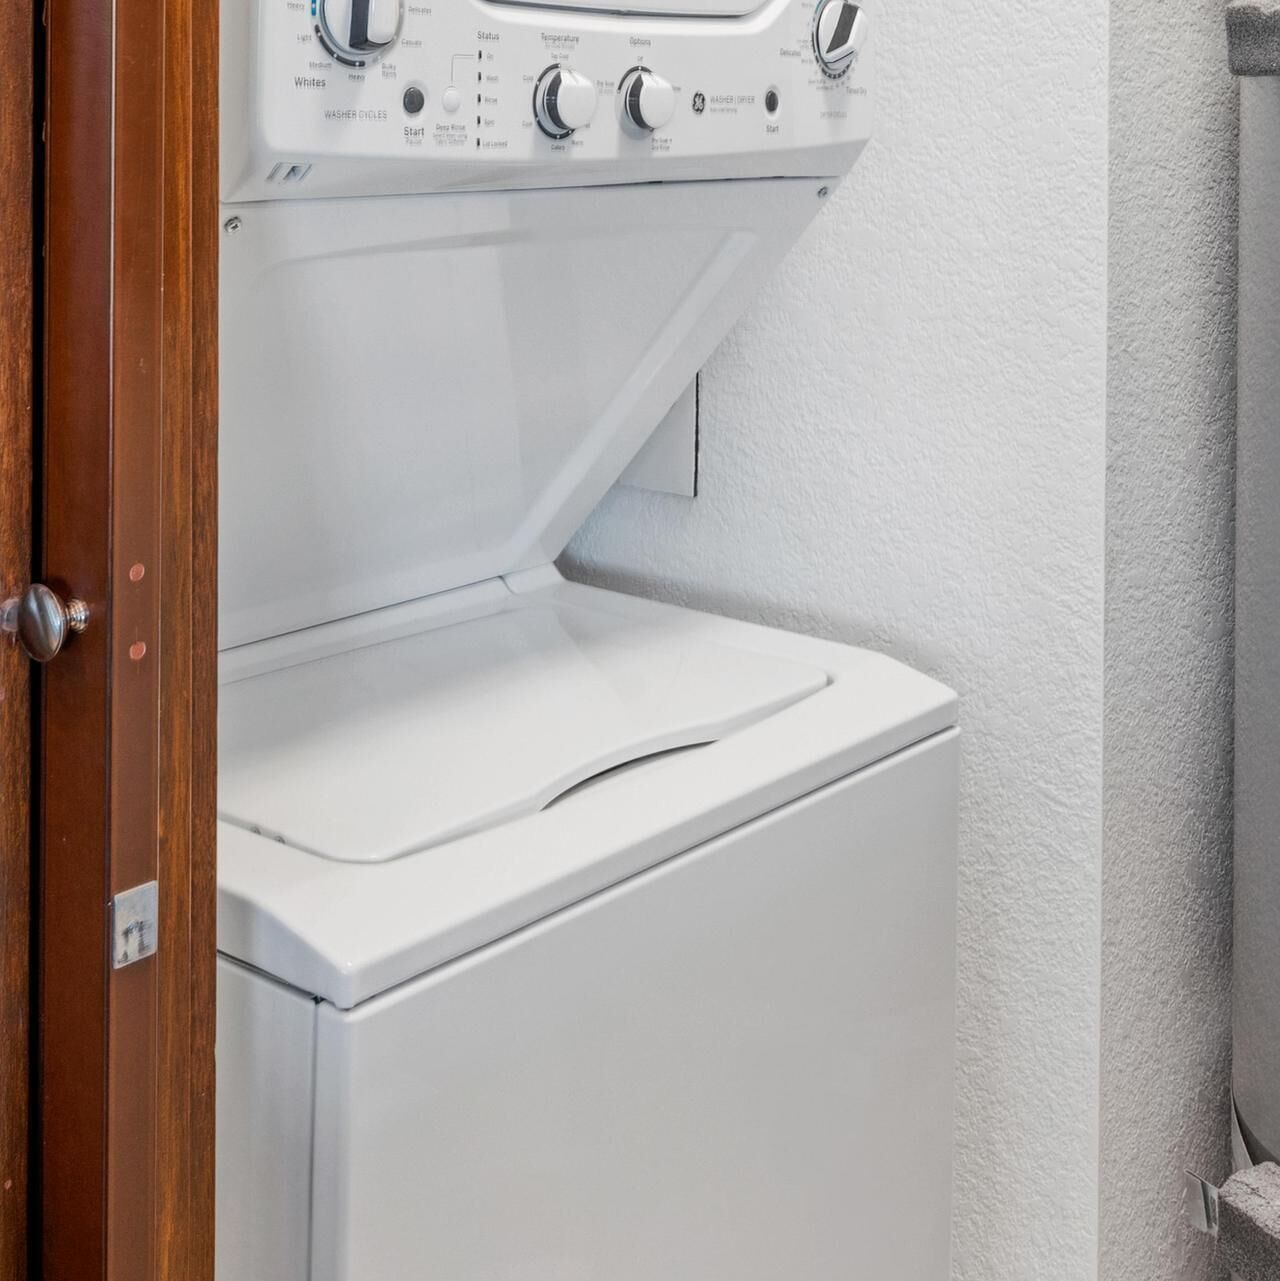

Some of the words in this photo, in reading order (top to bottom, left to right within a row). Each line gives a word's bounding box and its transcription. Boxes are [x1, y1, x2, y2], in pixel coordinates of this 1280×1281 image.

[477, 31, 500, 41] Status
[541, 32, 579, 43] Temperature
[629, 36, 652, 46] Options
[294, 76, 326, 87] Whites
[710, 95, 733, 104] WASHER
[324, 110, 357, 119] WASHER
[358, 111, 387, 120] CYCLES
[404, 126, 425, 136] Start
[766, 125, 779, 133] Start
